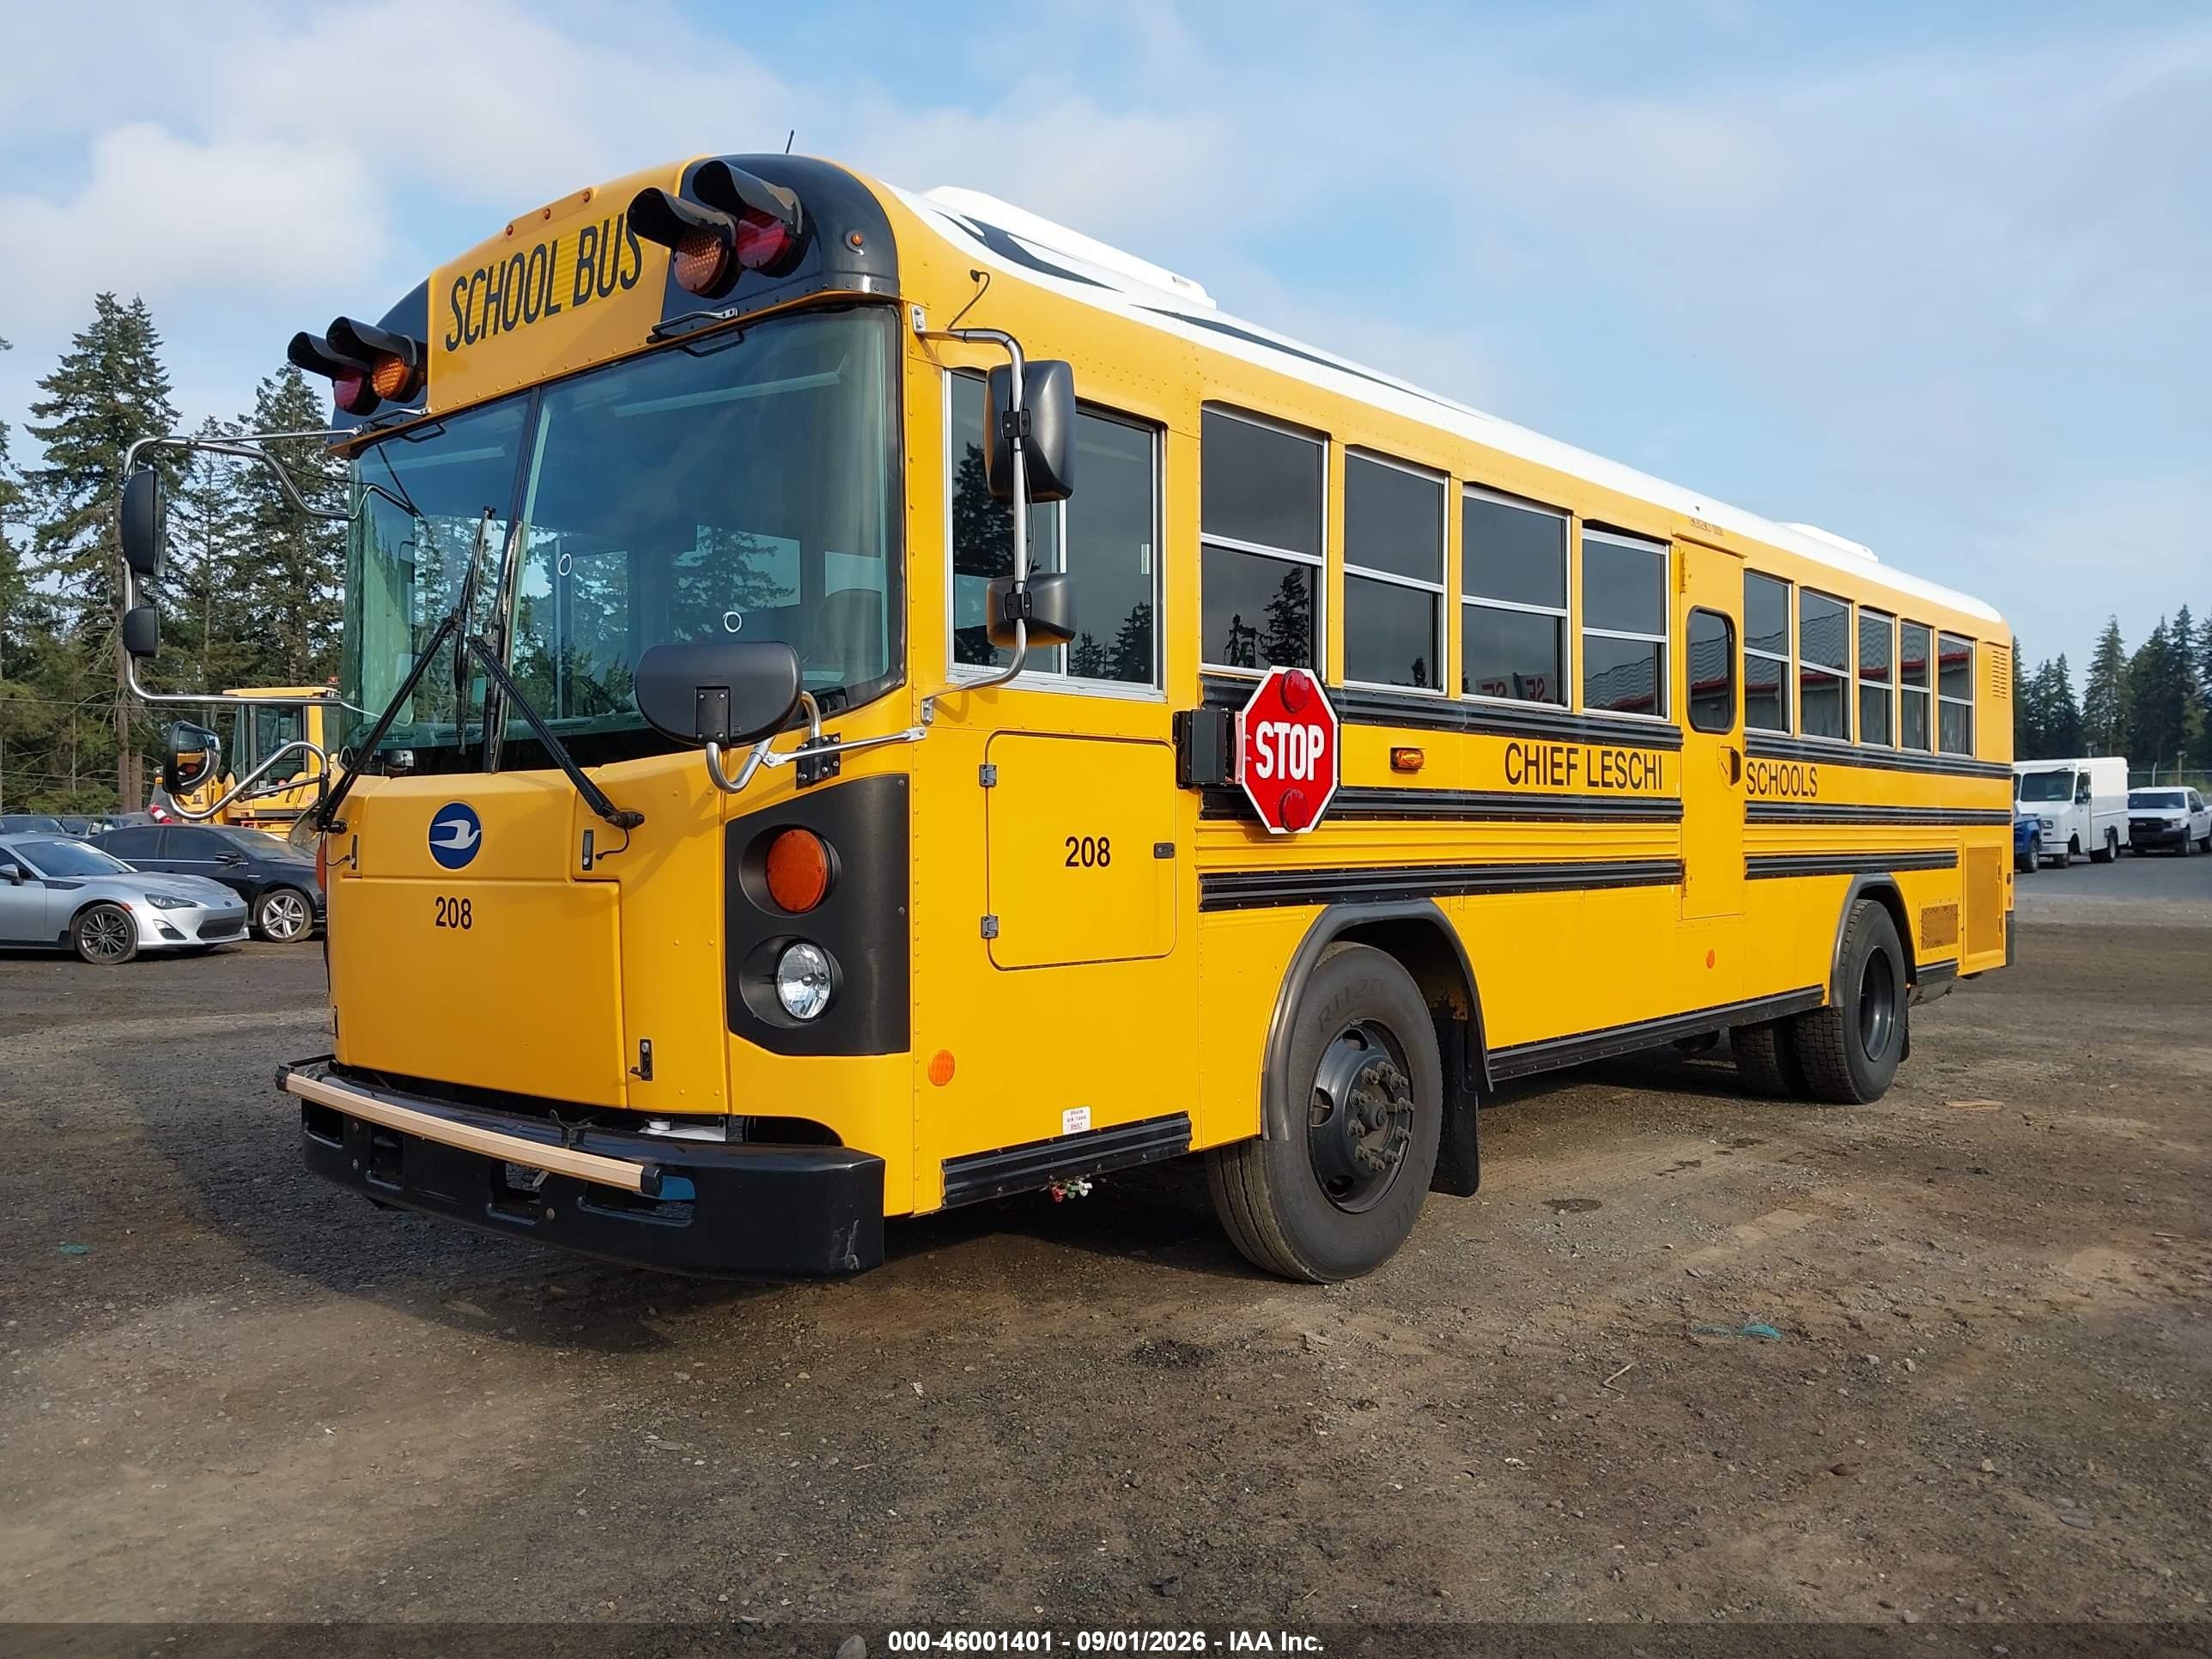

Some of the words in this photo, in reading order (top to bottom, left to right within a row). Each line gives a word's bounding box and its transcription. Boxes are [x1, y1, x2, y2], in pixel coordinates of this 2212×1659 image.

[445, 240, 562, 352] SCHOOL
[572, 213, 642, 307] BUS
[1255, 720, 1325, 781] STOP
[1504, 742, 1579, 786] CHIEF
[1587, 749, 1662, 791] LESCHI
[1746, 761, 1818, 798] SCHOOLS
[1065, 836, 1111, 868] 208
[434, 896, 472, 930] 208
